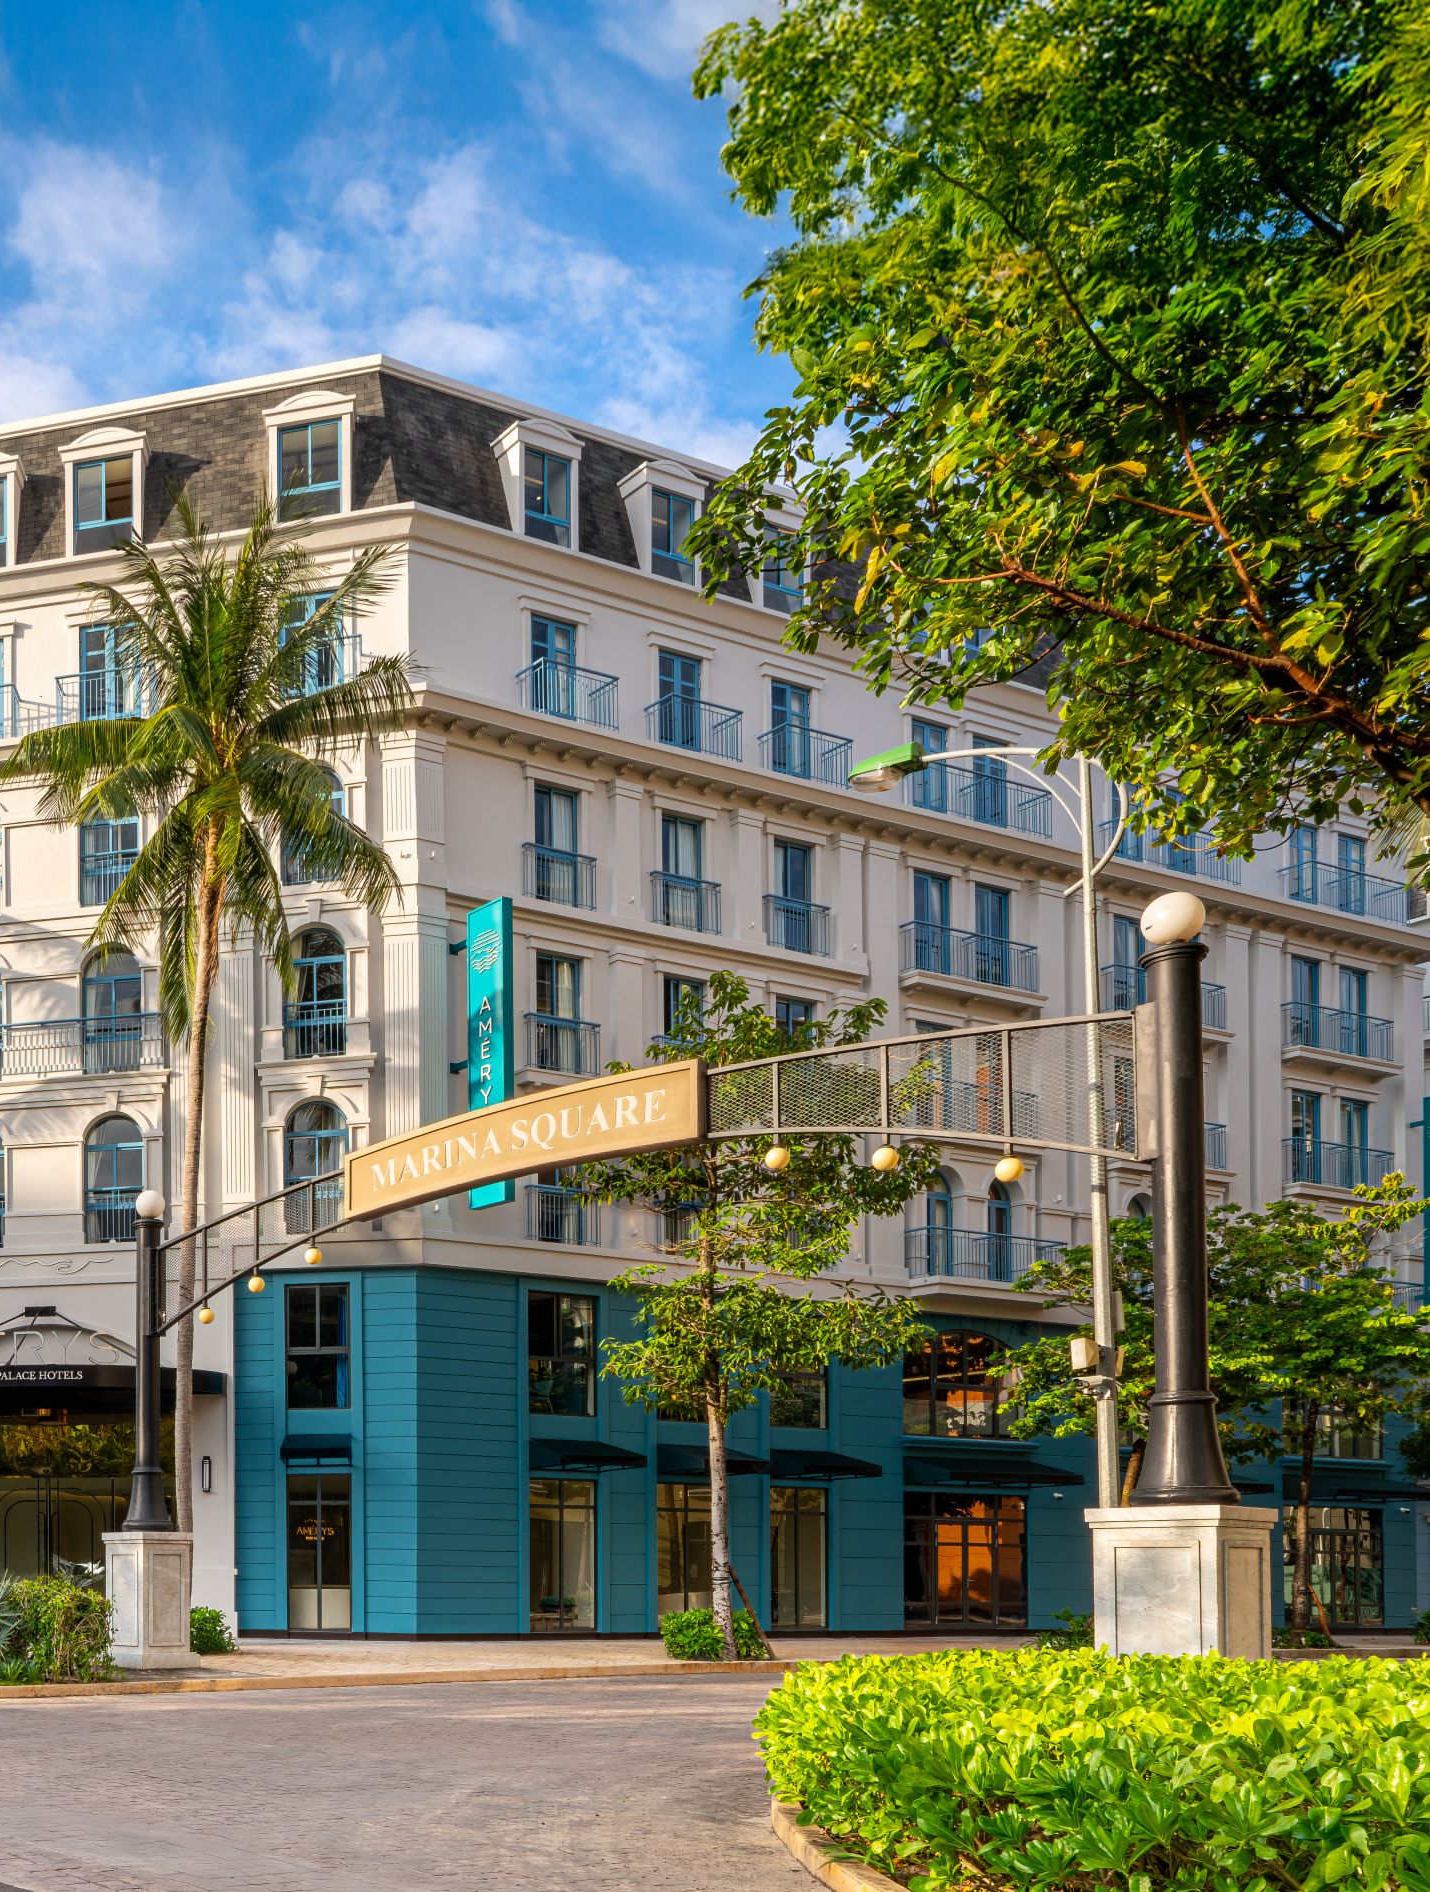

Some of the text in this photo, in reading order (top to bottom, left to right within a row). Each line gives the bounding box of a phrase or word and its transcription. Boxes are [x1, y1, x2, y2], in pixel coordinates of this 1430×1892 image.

[478, 995, 493, 1105] AMÉRY
[371, 1088, 666, 1192] MARINA SQUARE
[39, 1370, 83, 1381] HOTELS
